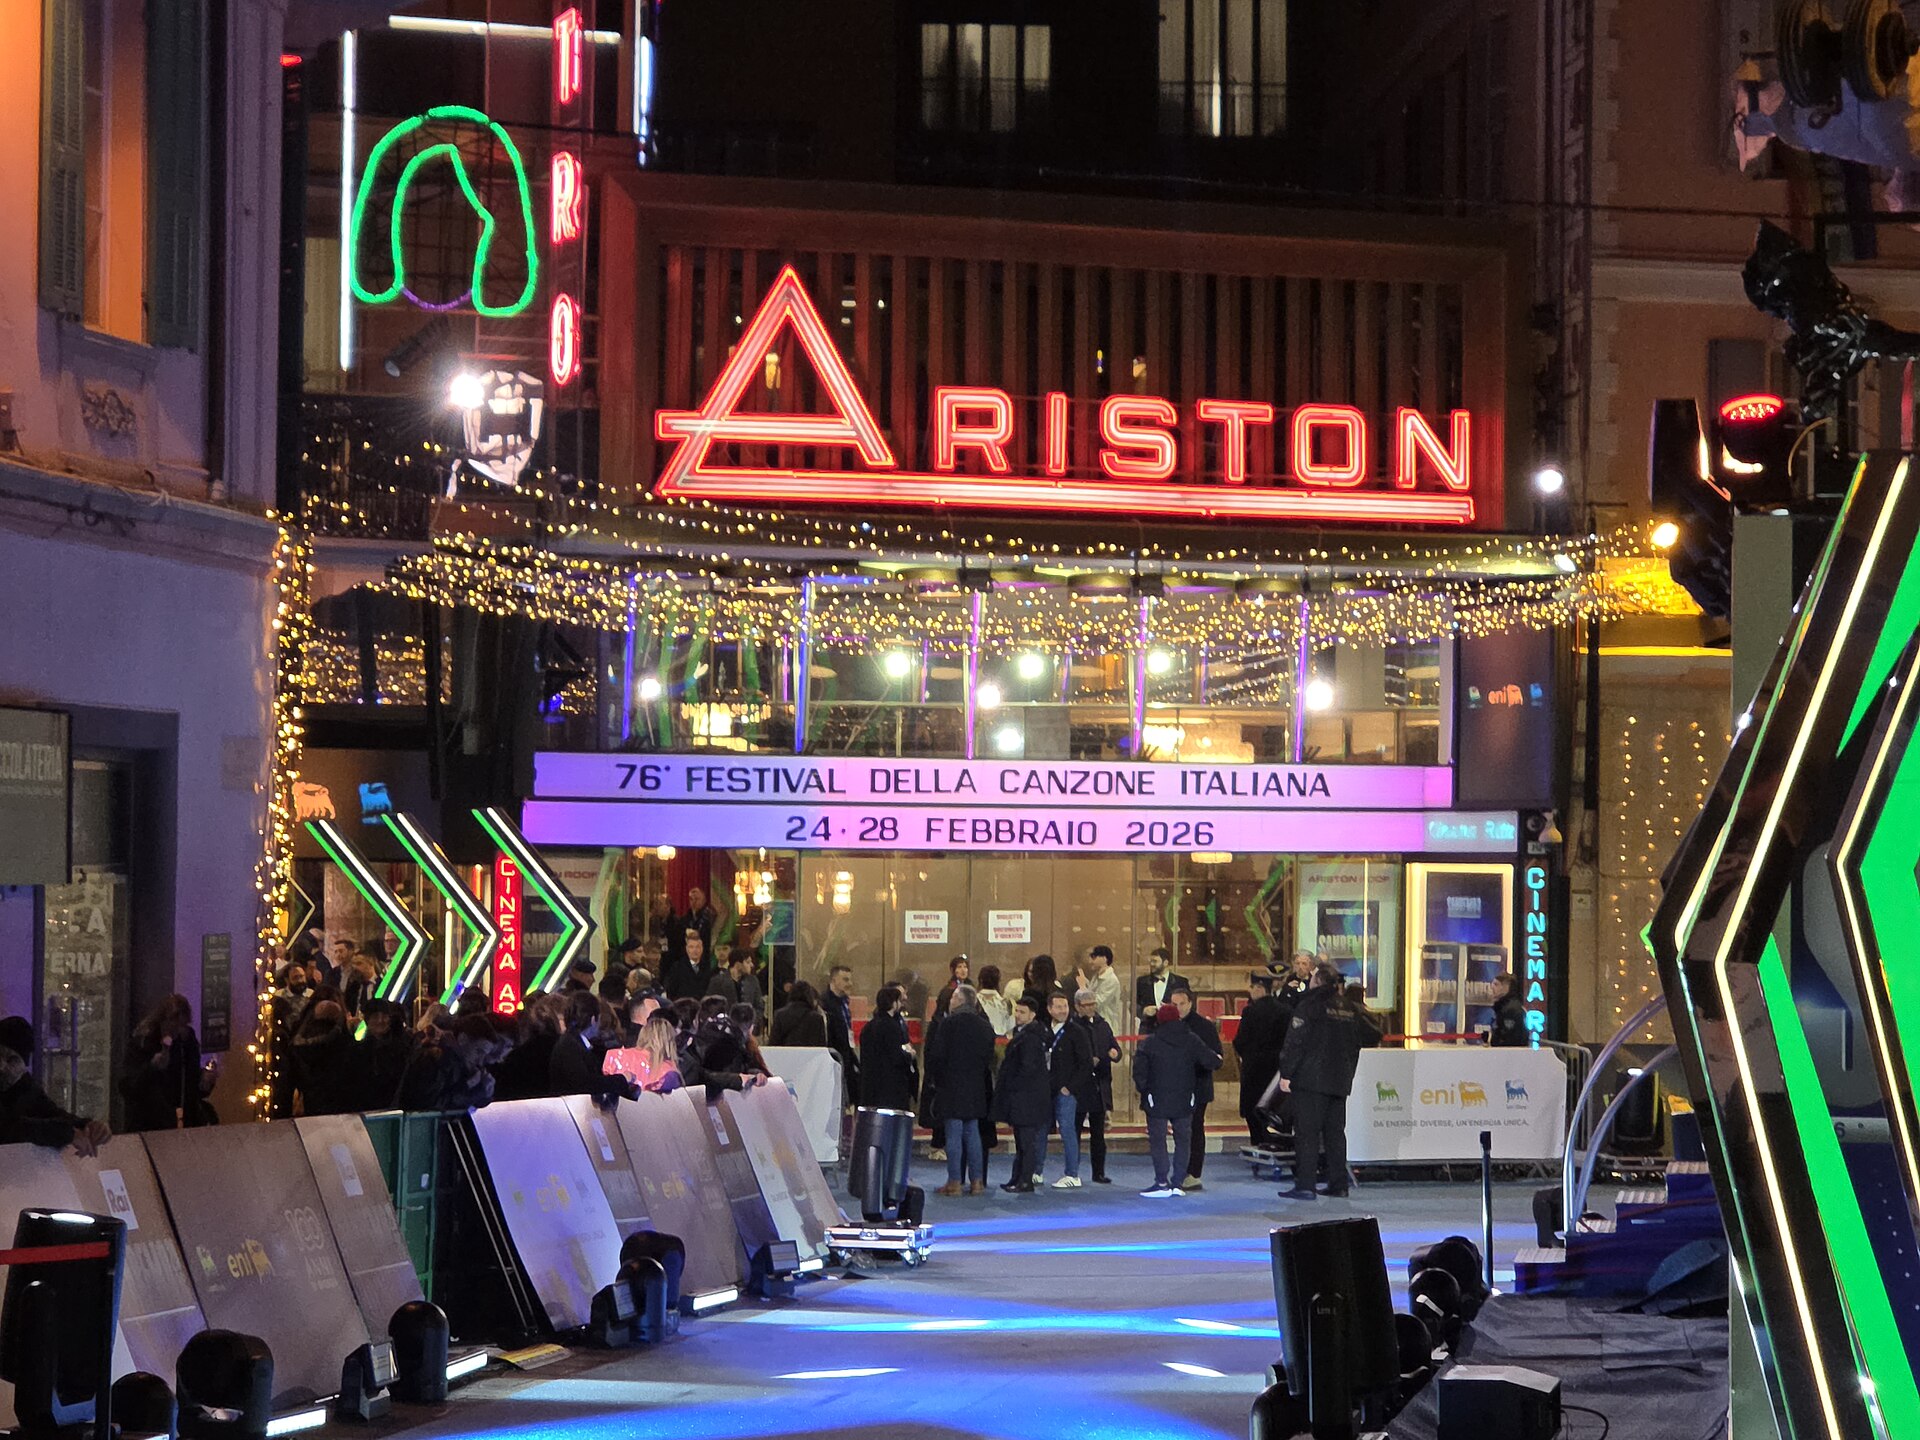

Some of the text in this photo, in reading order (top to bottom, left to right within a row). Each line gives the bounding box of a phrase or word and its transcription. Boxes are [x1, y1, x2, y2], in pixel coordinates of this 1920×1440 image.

[655, 264, 1476, 524] ARISTON
[685, 766, 846, 793] FESTIVAL
[870, 768, 977, 794] DELLA
[999, 769, 1155, 795] CANZONE
[1181, 770, 1331, 797] ITALIANA
[926, 817, 1097, 845] FEBBRAIO
[1125, 821, 1215, 846] 2026
[499, 858, 517, 971] CINEMA
[1526, 866, 1547, 1003] CINEMA
[1419, 1083, 1455, 1105] eni
[106, 1185, 131, 1213] Rai
[227, 1243, 254, 1279] eni
